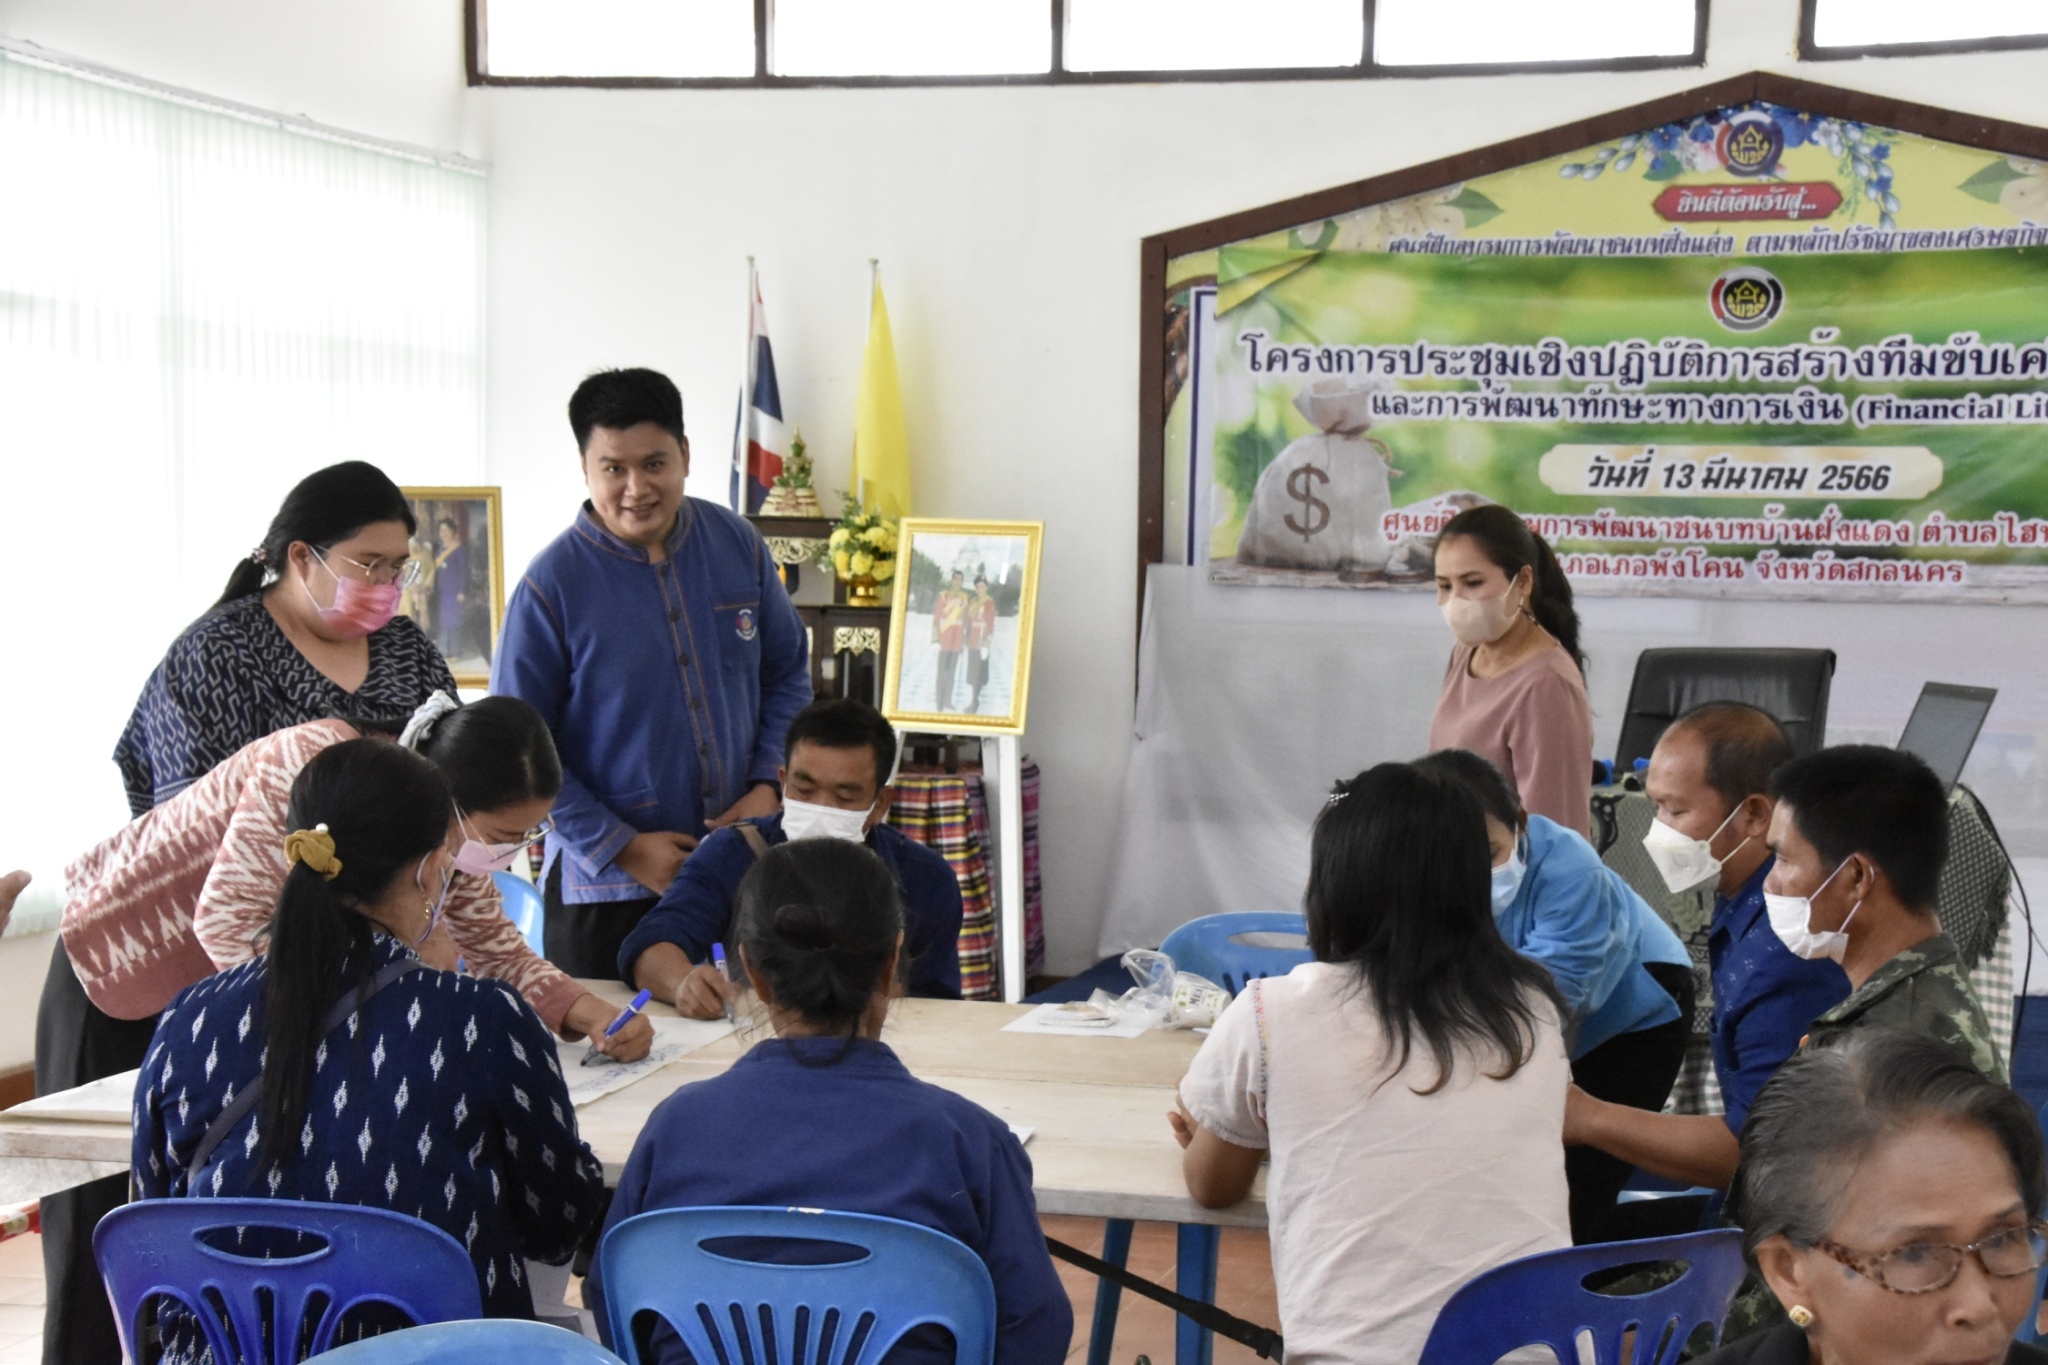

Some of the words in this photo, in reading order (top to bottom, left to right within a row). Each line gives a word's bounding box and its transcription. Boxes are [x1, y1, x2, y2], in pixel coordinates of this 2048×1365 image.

[1372, 388, 1843, 420] และการพัฒนาทักษะทางการเงิน
[1856, 397, 2004, 424] (Financial
[1588, 448, 1655, 488] วันที่
[1662, 463, 1695, 488] 13
[1701, 456, 1808, 490] มีนาคม
[1817, 465, 1891, 491] 2566
[1756, 552, 1963, 582] จังหวัดสกลนคร
